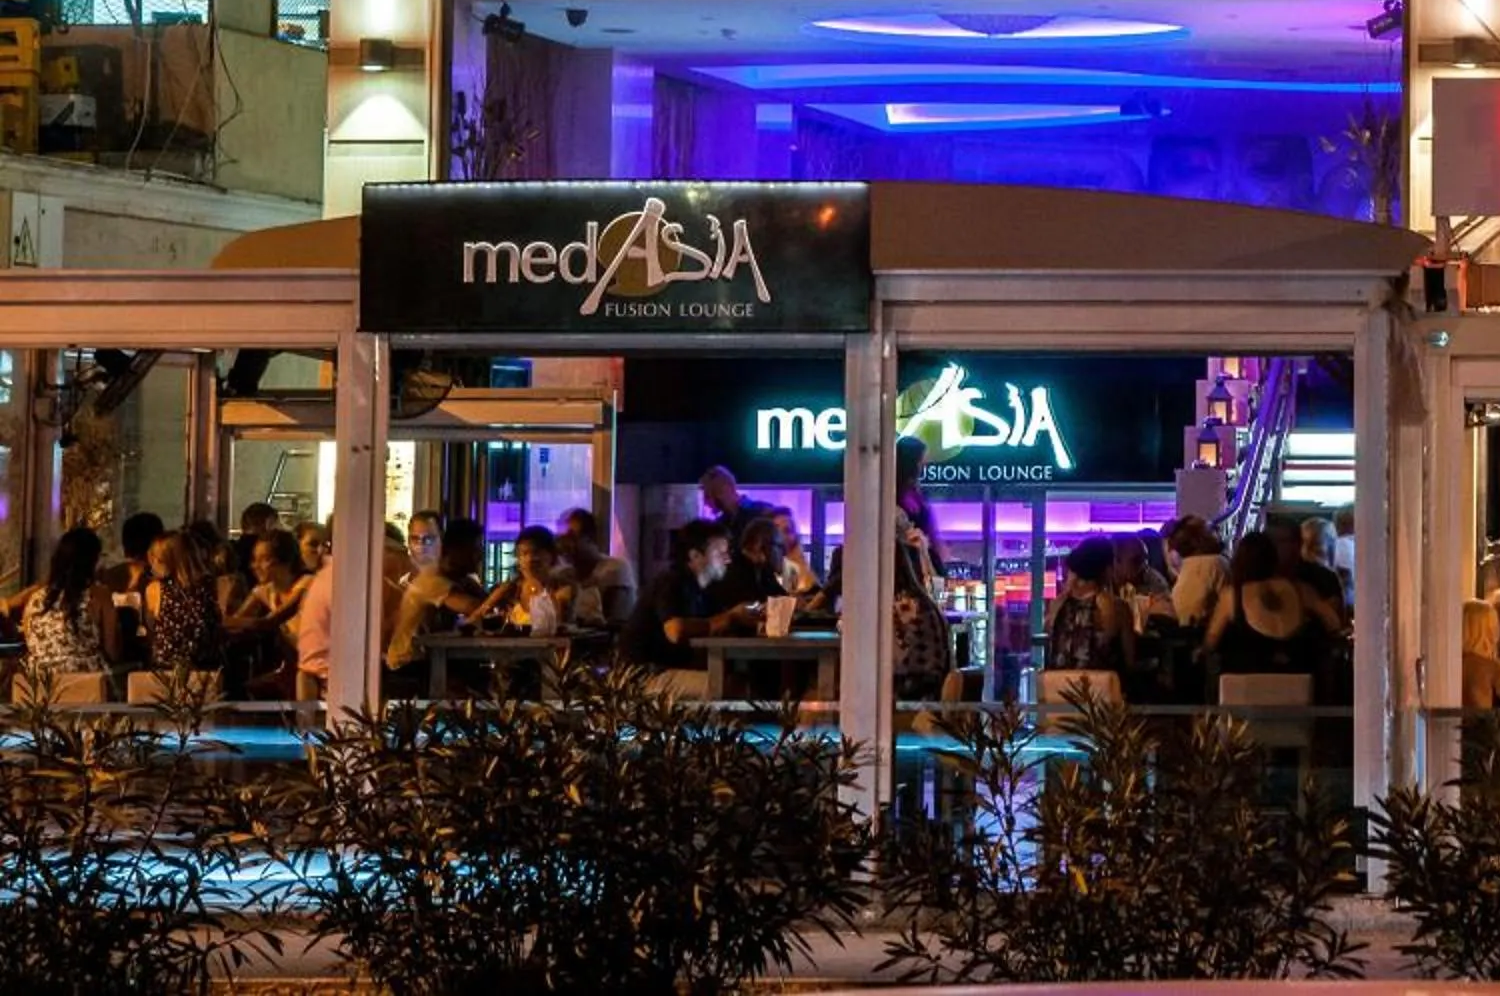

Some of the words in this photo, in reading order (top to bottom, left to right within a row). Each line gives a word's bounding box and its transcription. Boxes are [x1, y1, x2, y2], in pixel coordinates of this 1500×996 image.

[605, 303, 671, 317] FUSION
[680, 303, 754, 317] LOUNGE
[918, 465, 971, 481] USION
[979, 465, 1053, 481] LOUNGE
